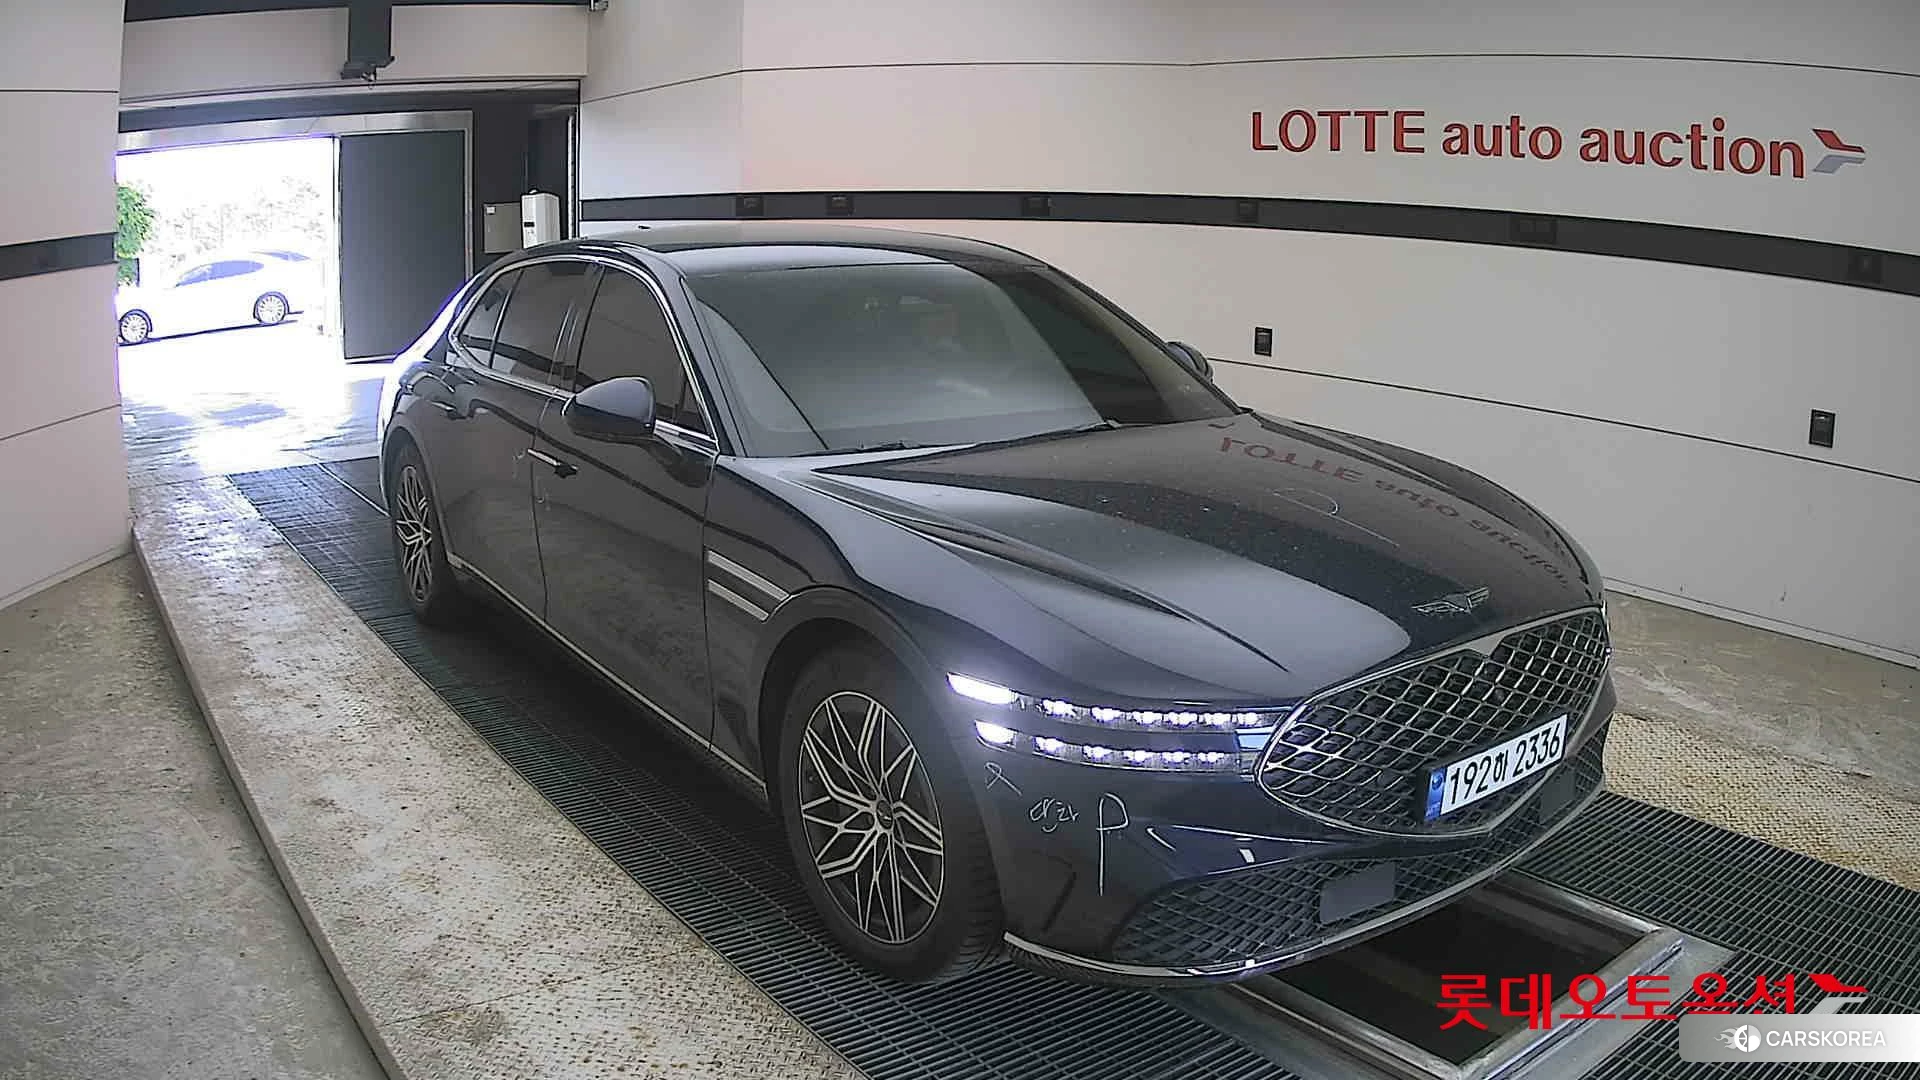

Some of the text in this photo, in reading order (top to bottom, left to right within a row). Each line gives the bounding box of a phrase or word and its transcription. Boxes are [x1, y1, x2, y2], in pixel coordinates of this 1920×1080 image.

[1251, 111, 1805, 178] LOTTE auto auction
[1450, 722, 1560, 804] 192하 2336
